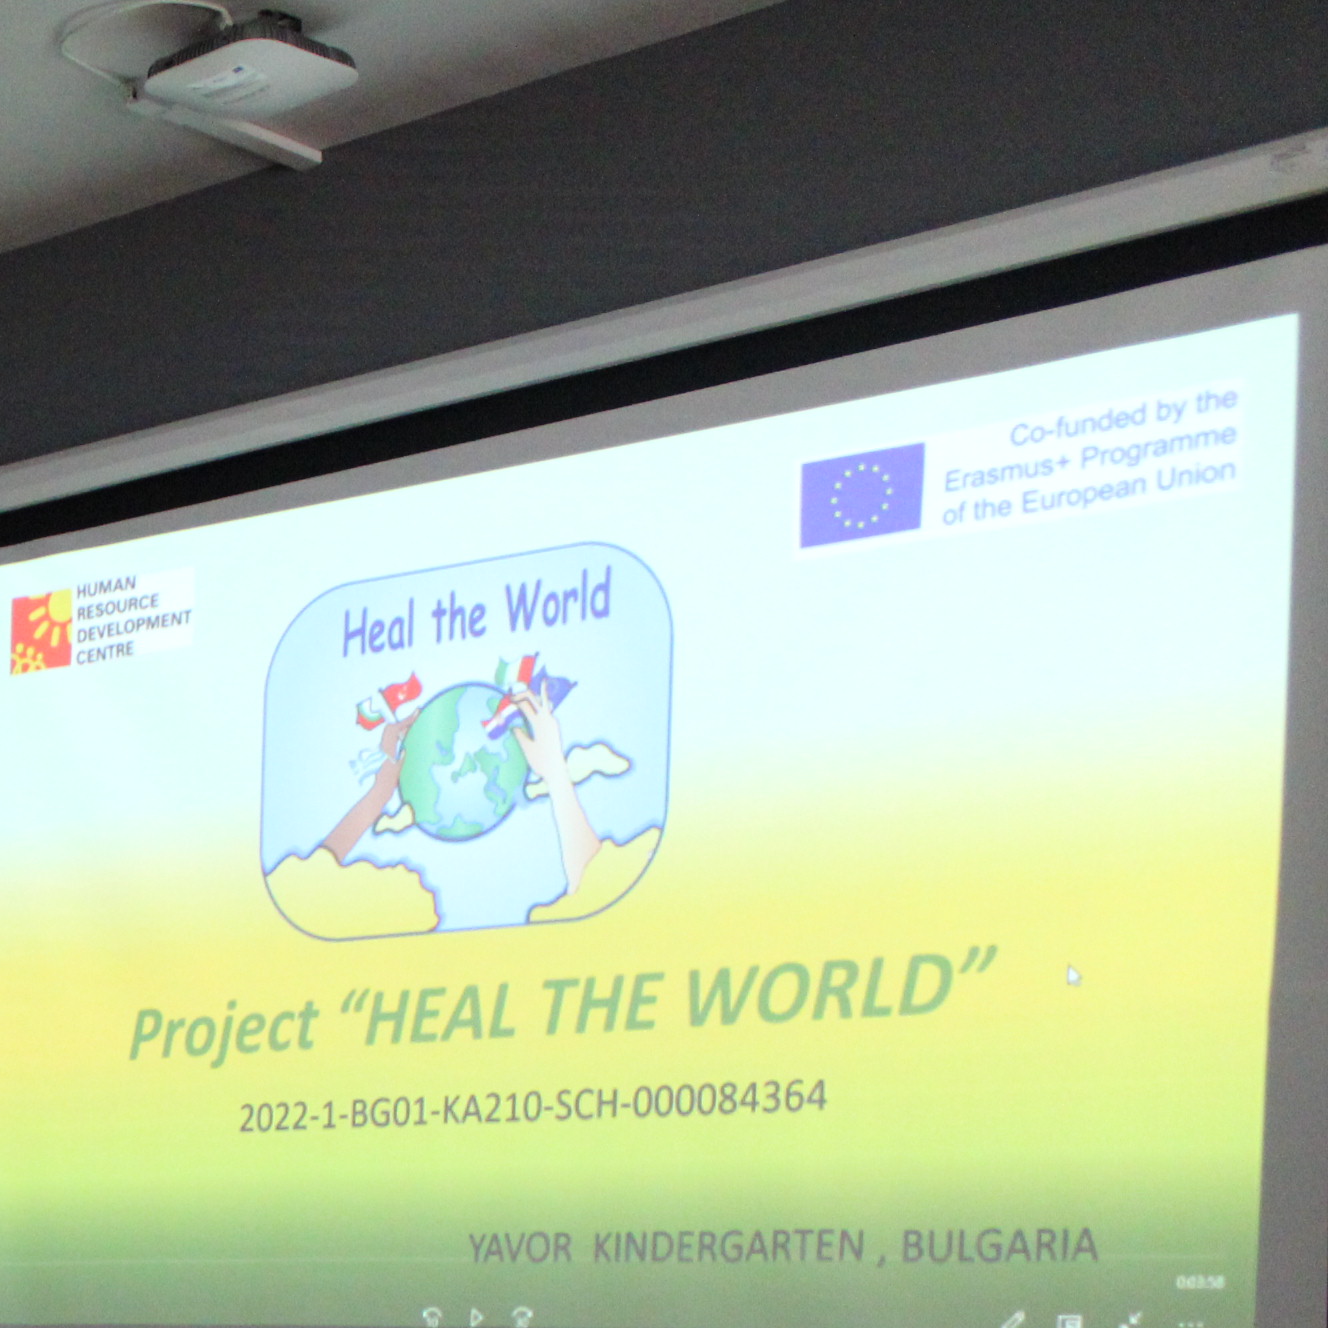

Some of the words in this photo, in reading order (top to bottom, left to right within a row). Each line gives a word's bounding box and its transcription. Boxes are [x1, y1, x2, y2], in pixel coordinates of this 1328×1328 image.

[1010, 400, 1147, 447] Co-funded
[1155, 394, 1187, 424] by
[1197, 386, 1239, 415] the
[945, 453, 1072, 493] Erasmus+
[1080, 425, 1238, 469] Programme
[942, 499, 967, 526] of
[973, 495, 1012, 522] the
[1022, 475, 1148, 514] European
[1157, 461, 1237, 491] Union
[77, 576, 136, 599] HUMAN
[77, 593, 159, 620] RESOURCE
[342, 598, 414, 658] Heal
[432, 590, 487, 645] the
[505, 564, 612, 633] World
[76, 641, 133, 665] CENTRE
[77, 609, 192, 643] DEVELOPMENT
[129, 999, 321, 1070] Project
[340, 981, 516, 1047] “HEAL
[541, 971, 666, 1036] THE
[687, 943, 999, 1028] WORLD”
[239, 1078, 827, 1134] 2022-1-BG01-KA210-SCH-000084364
[469, 1231, 573, 1264] YAVOR
[594, 1228, 866, 1265] KINDERGARTEN
[901, 1226, 1100, 1264] BULGARIA
